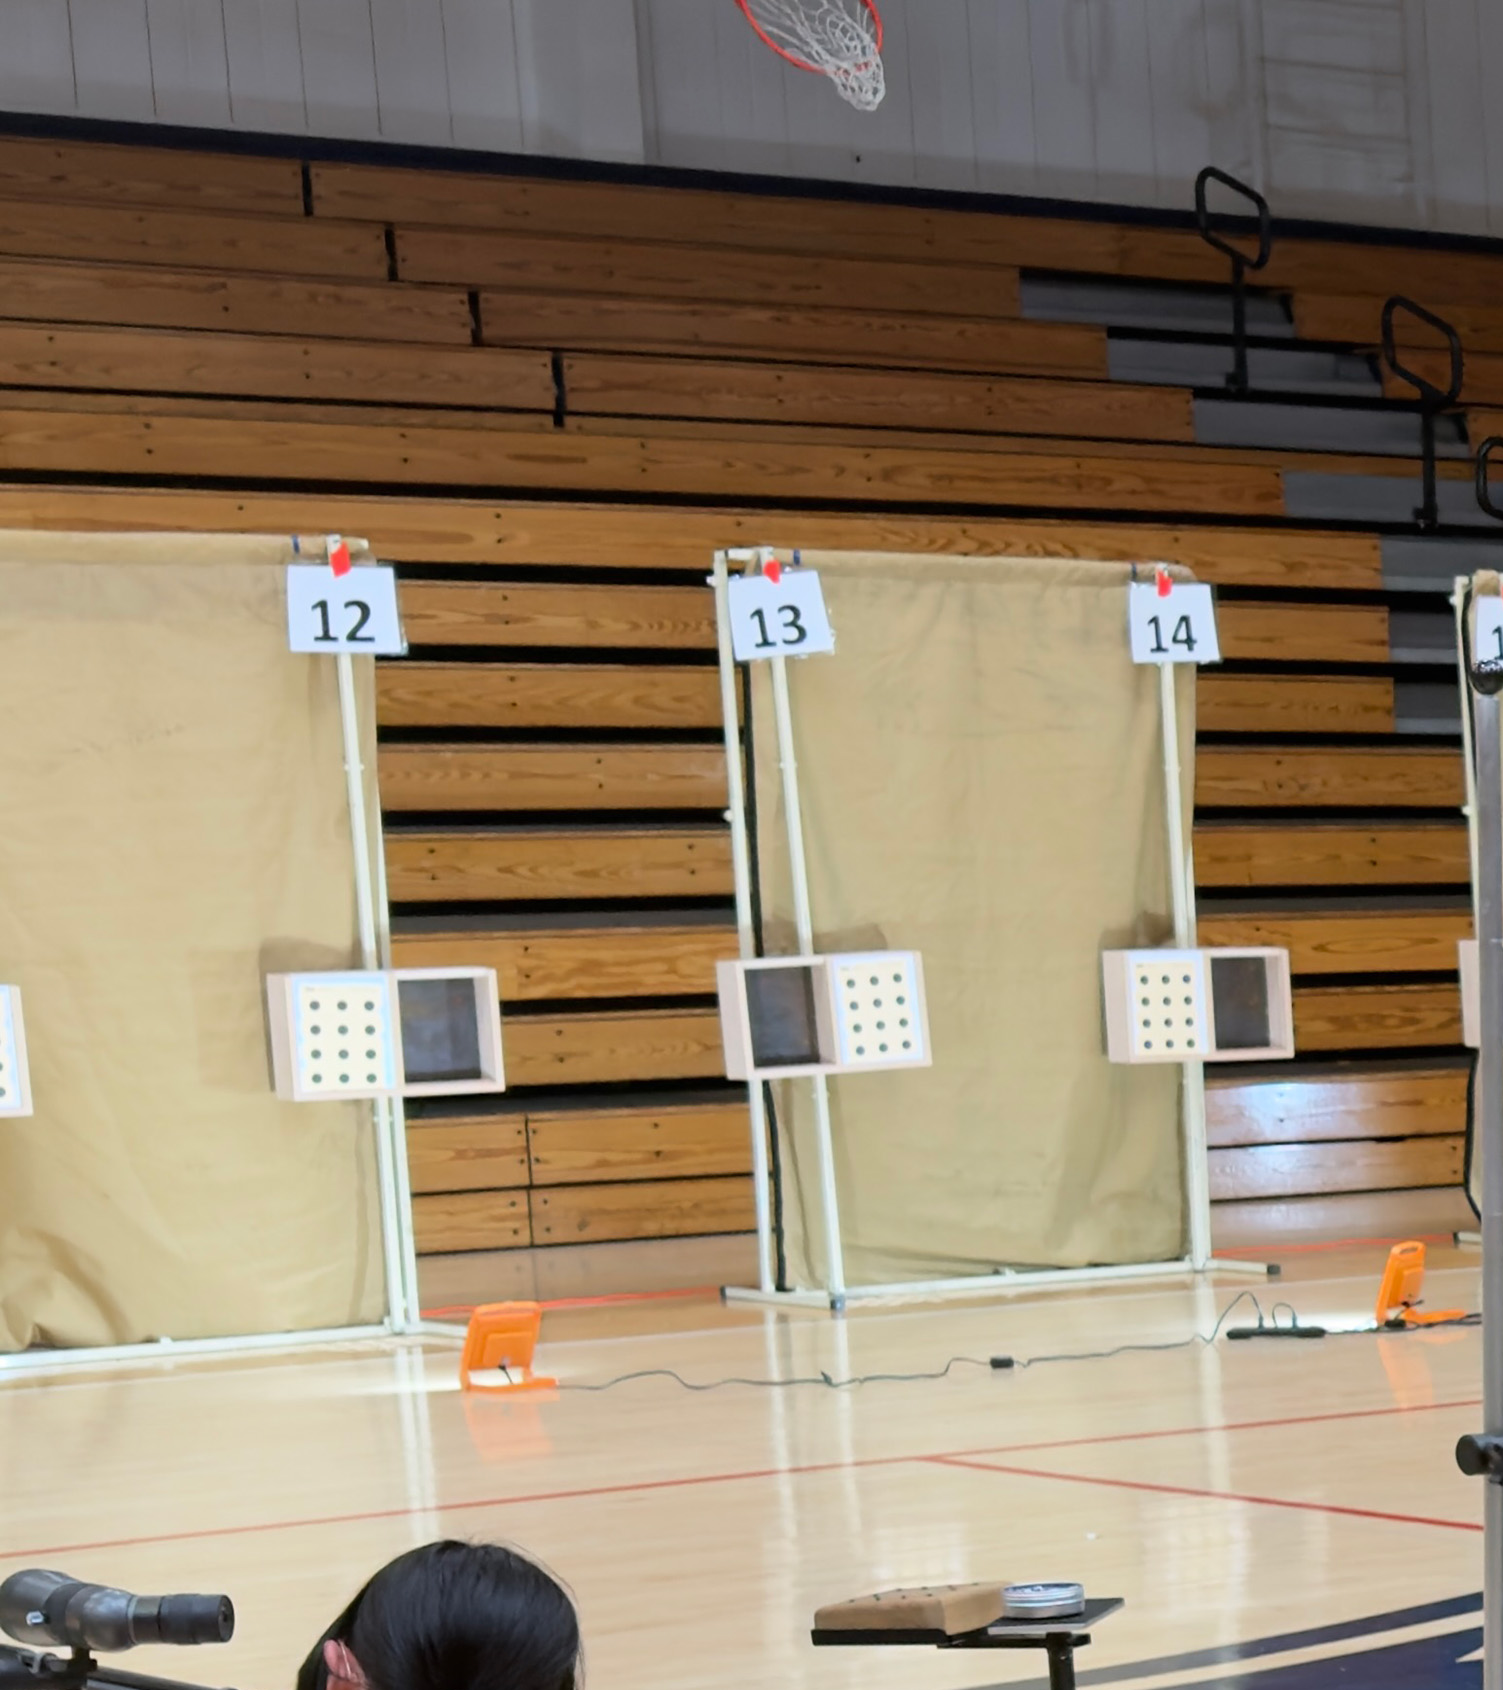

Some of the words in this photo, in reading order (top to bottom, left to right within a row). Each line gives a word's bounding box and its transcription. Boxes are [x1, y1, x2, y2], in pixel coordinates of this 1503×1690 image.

[311, 600, 375, 642] 12
[750, 604, 807, 648] 13
[1147, 615, 1197, 653] 14
